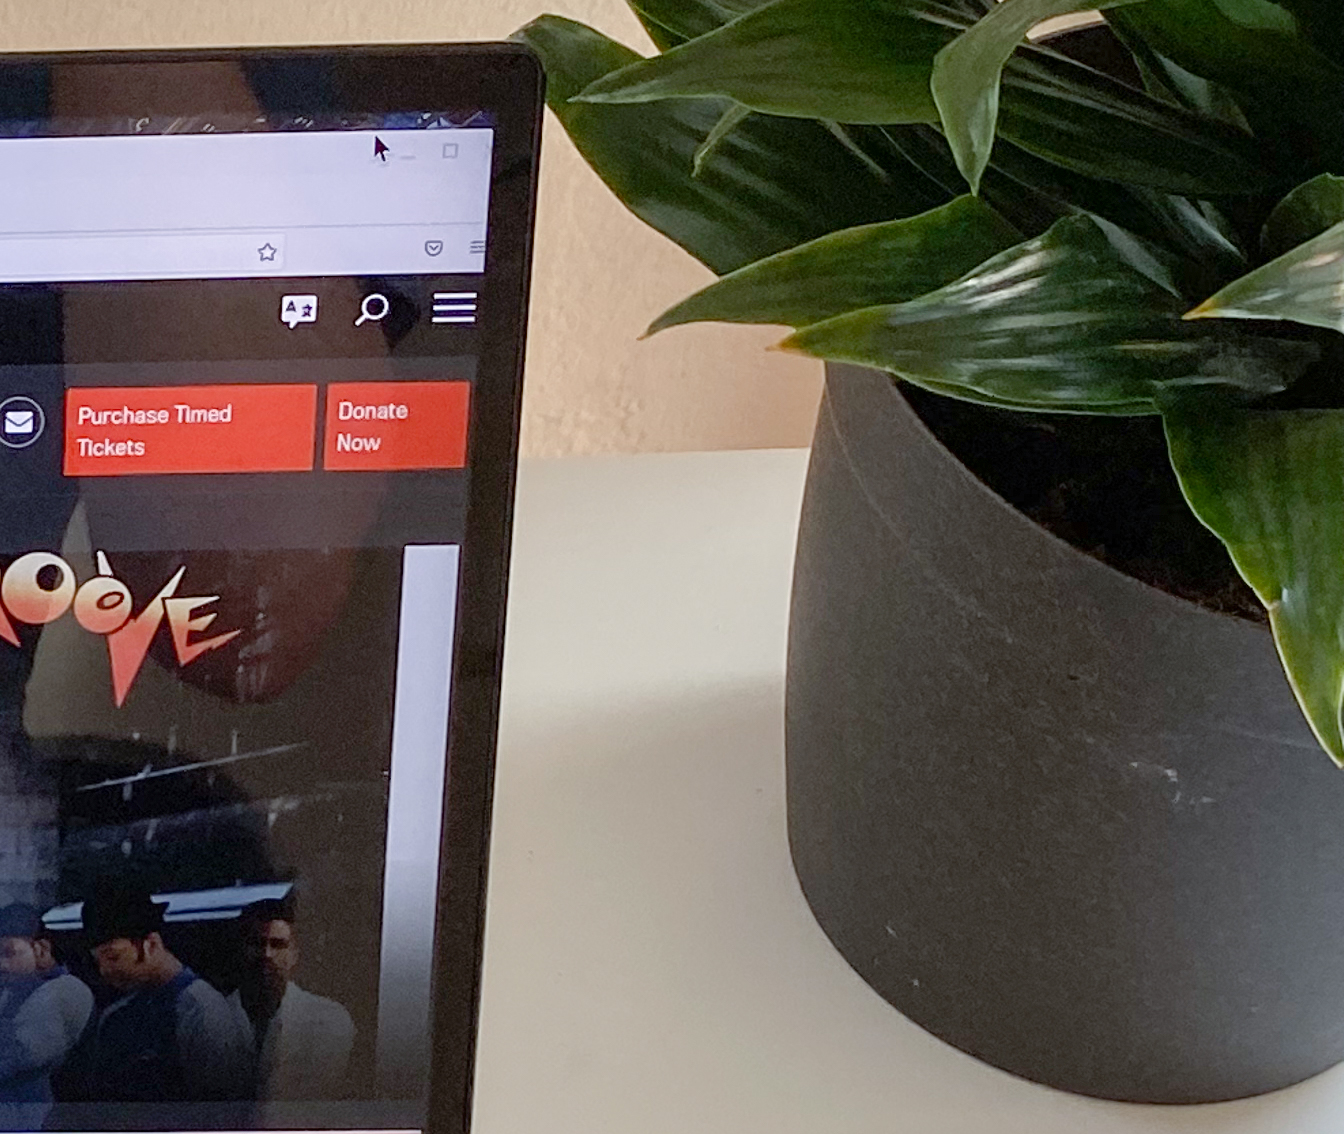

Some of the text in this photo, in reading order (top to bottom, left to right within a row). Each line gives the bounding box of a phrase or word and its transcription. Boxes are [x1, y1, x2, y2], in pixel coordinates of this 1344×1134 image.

[78, 404, 231, 425] Purchase Timed
[339, 402, 407, 420] Donate
[76, 439, 145, 456] Tickets
[337, 433, 381, 451] Now
